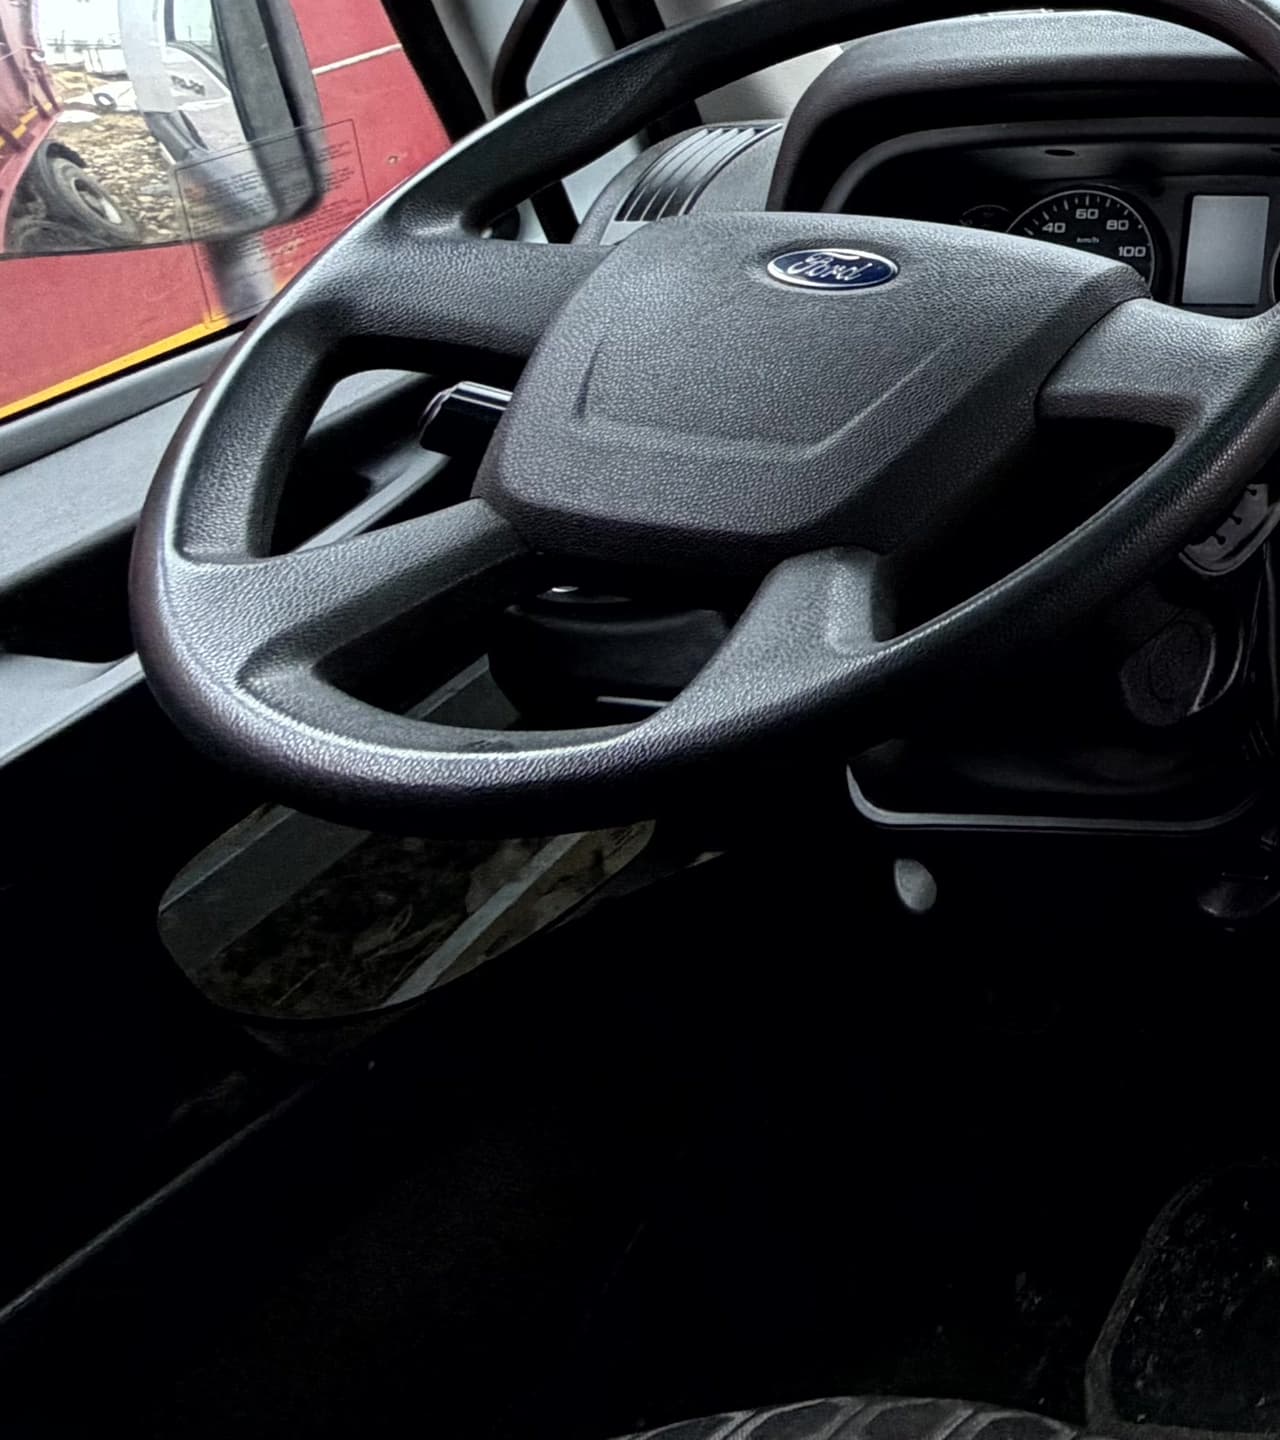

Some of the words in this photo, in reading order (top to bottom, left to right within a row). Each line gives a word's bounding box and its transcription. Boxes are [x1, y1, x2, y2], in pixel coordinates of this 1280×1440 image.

[1075, 209, 1099, 219] 60
[1042, 222, 1066, 233] 40
[1106, 220, 1129, 230] 80
[1118, 246, 1146, 257] 100
[787, 252, 873, 281] Ford
